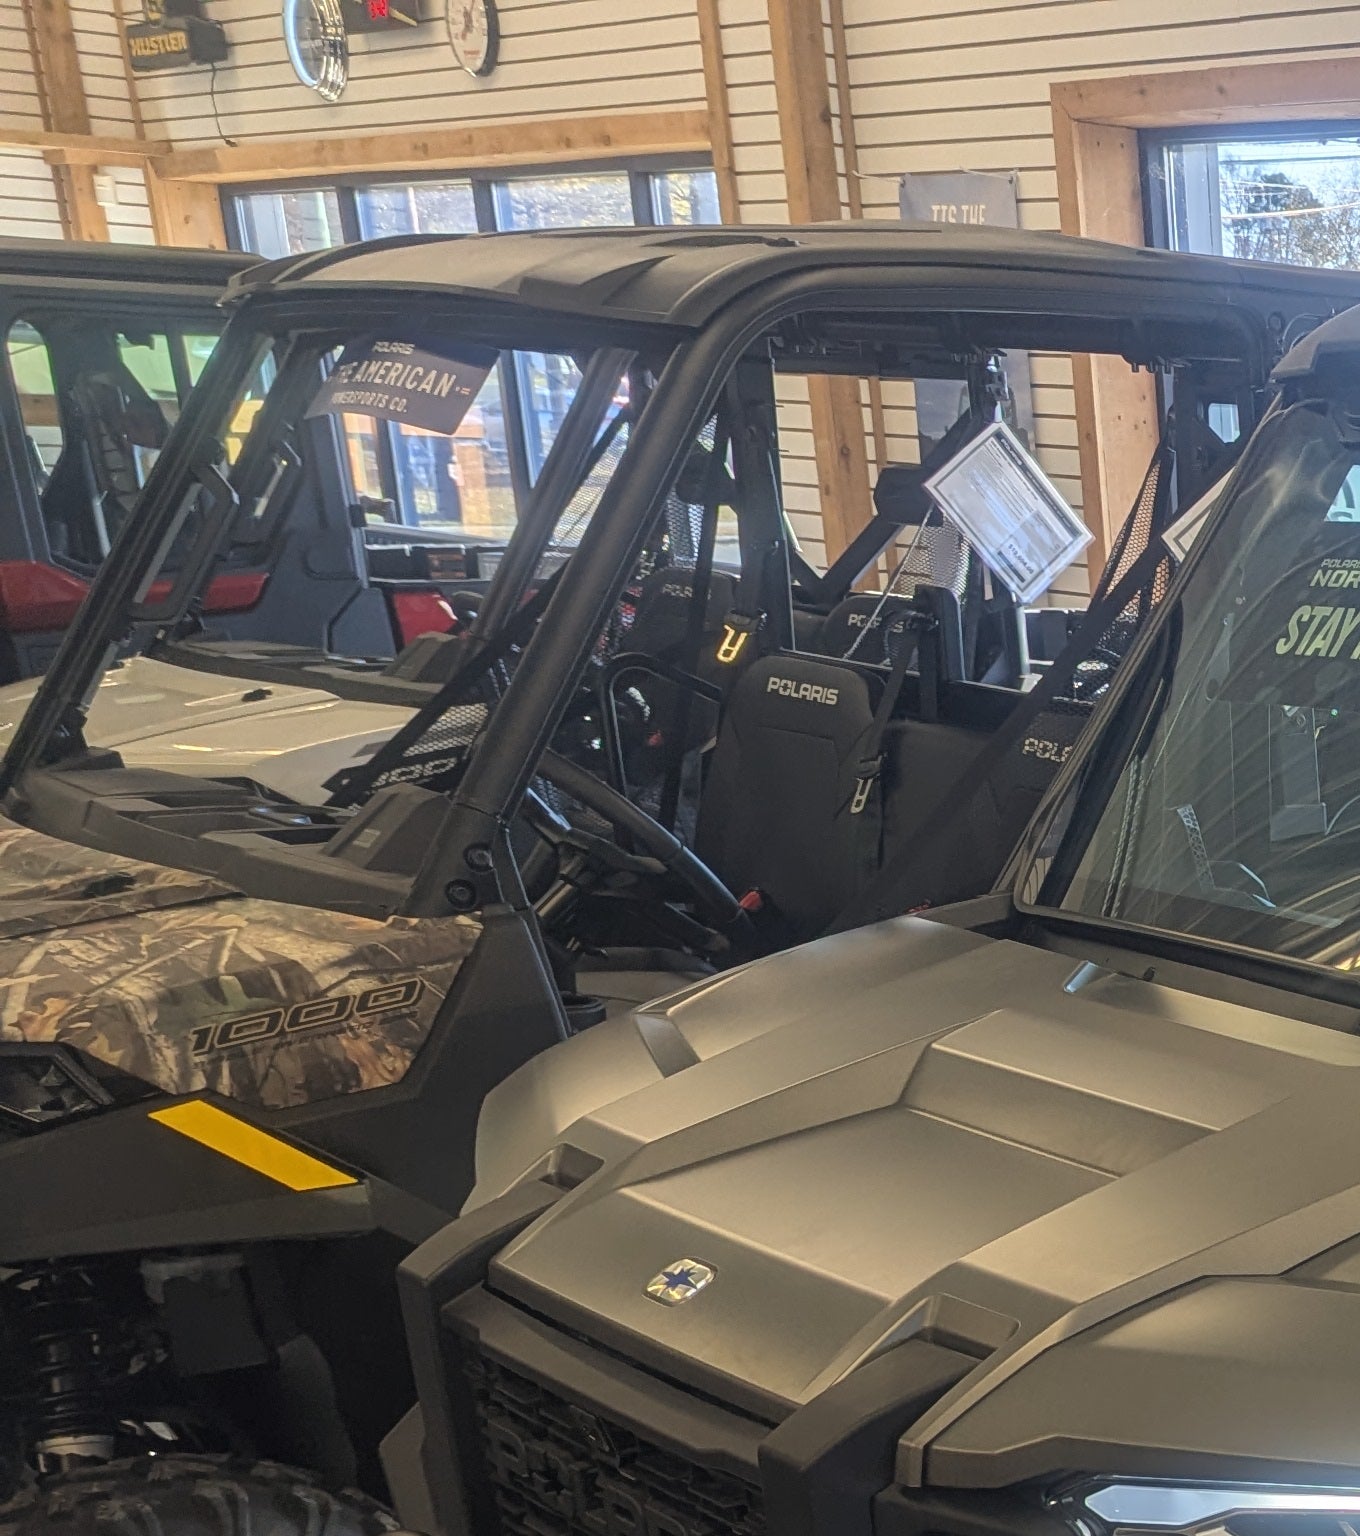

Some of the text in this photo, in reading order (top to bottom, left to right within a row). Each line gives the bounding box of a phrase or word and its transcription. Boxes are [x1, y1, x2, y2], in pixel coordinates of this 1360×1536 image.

[131, 31, 188, 57] HUSTLER
[353, 360, 457, 398] AMERICAN
[766, 676, 840, 706] POLARIS
[190, 977, 426, 1058] 1000
